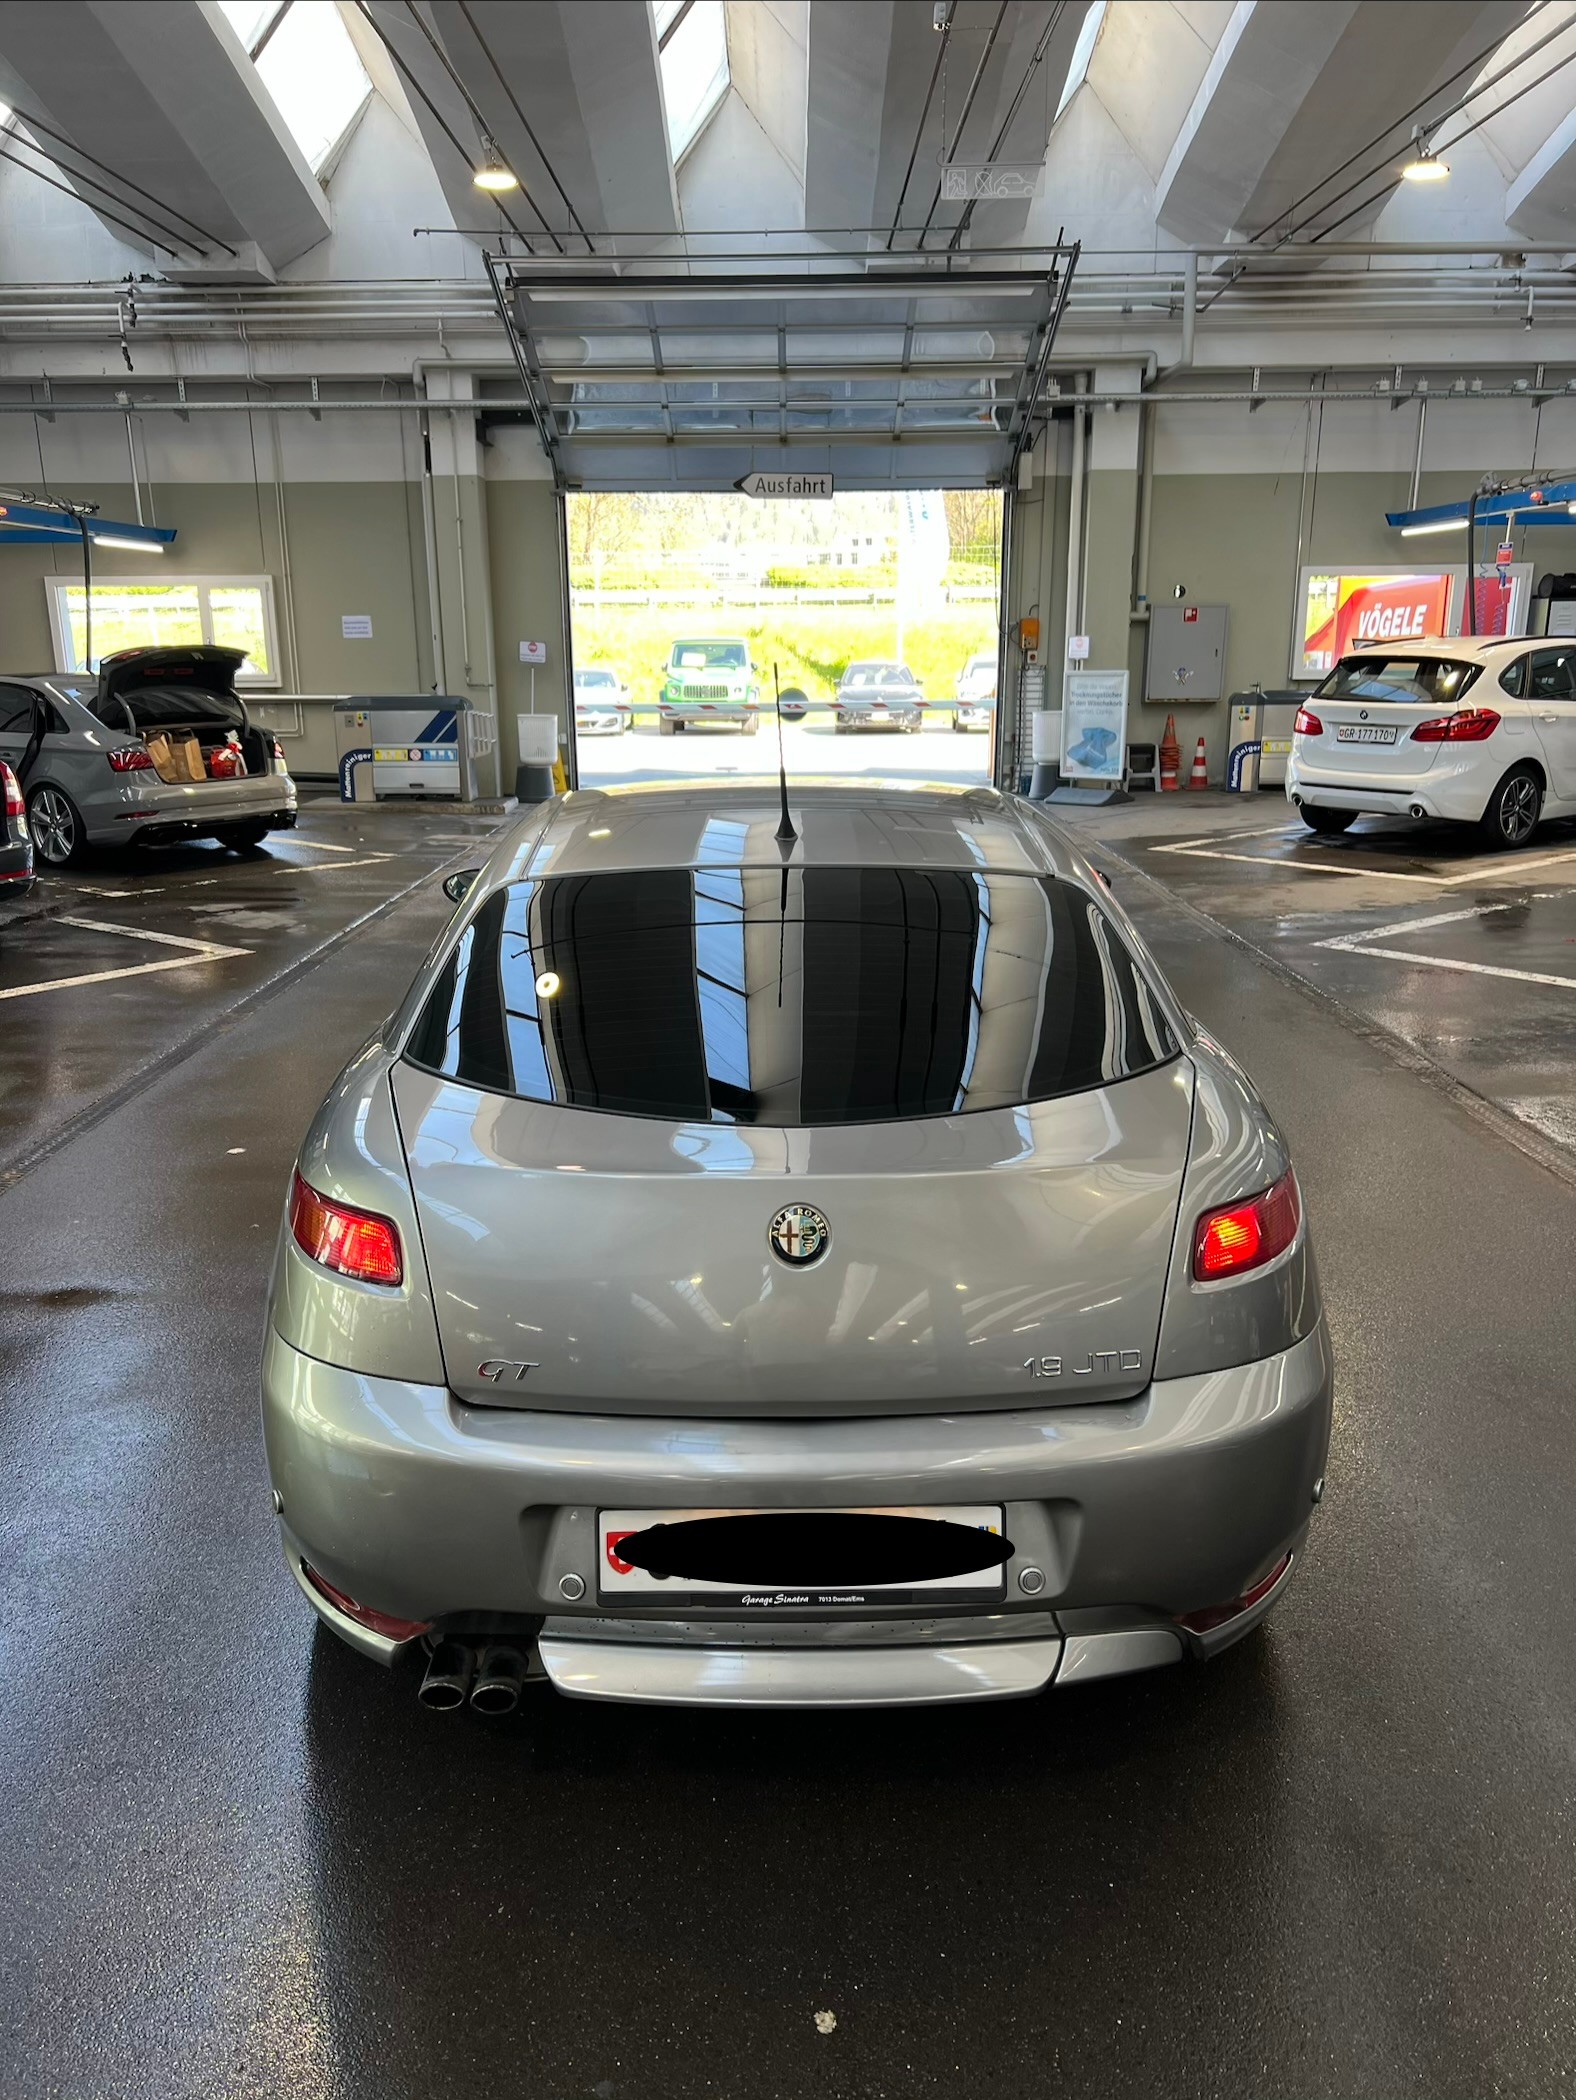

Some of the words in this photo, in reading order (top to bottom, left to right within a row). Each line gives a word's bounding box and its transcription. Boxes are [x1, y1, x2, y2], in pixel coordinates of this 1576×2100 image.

[755, 476, 826, 494] Ausfahrt
[1358, 603, 1428, 639] VÖGELE
[1344, 728, 1355, 739] GR
[1358, 729, 1389, 741] 177170
[771, 1211, 792, 1238] ALFA
[797, 1207, 827, 1238] ROMEO
[477, 1358, 541, 1383] GT
[1023, 1356, 1062, 1379] 1.9
[1072, 1349, 1142, 1375] JTD
[741, 1594, 773, 1606] Garage
[774, 1593, 809, 1605] Sinatra
